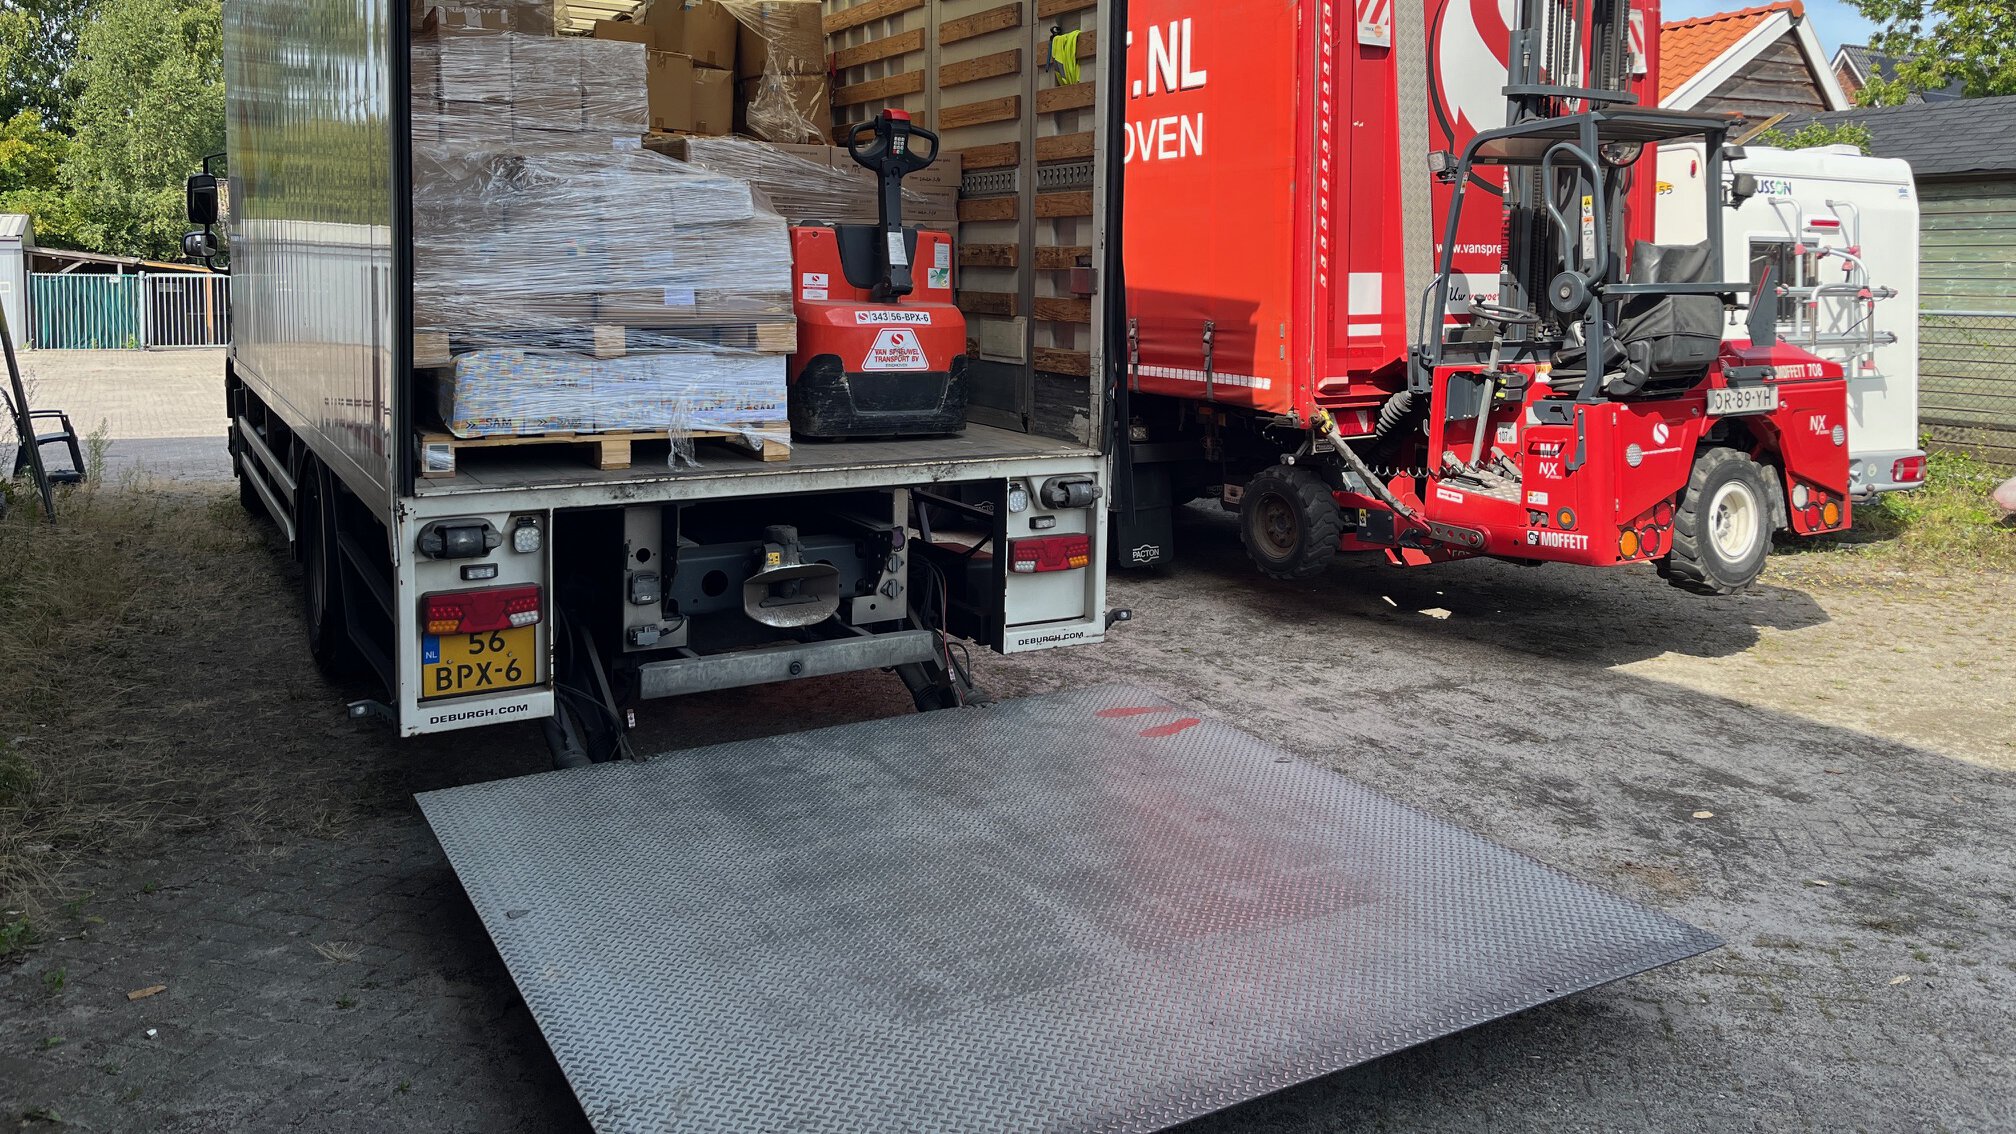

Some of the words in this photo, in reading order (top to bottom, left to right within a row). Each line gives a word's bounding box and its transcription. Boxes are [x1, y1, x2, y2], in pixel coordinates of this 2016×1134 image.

[1126, 18, 1207, 100] .NL
[1659, 185, 1673, 195] 55
[1436, 243, 1502, 256] ww.vanspre
[1450, 286, 1466, 301] Uw
[872, 313, 888, 321] 343
[891, 313, 929, 322] 56-BPX-6
[1774, 364, 1806, 379] MOFFETT
[1807, 363, 1823, 377] 708
[485, 418, 512, 428] SAM
[1809, 415, 1826, 434] NX
[1540, 443, 1559, 458] M4
[1539, 462, 1559, 478] NX
[1541, 532, 1588, 550] MOFFETT
[1133, 549, 1160, 559] PACTON
[469, 630, 506, 655] 56
[1018, 632, 1084, 646] DEBURGH.COM
[425, 651, 438, 660] NL
[436, 658, 522, 692] BPX-6
[430, 704, 529, 725] DEBURGH.COM
